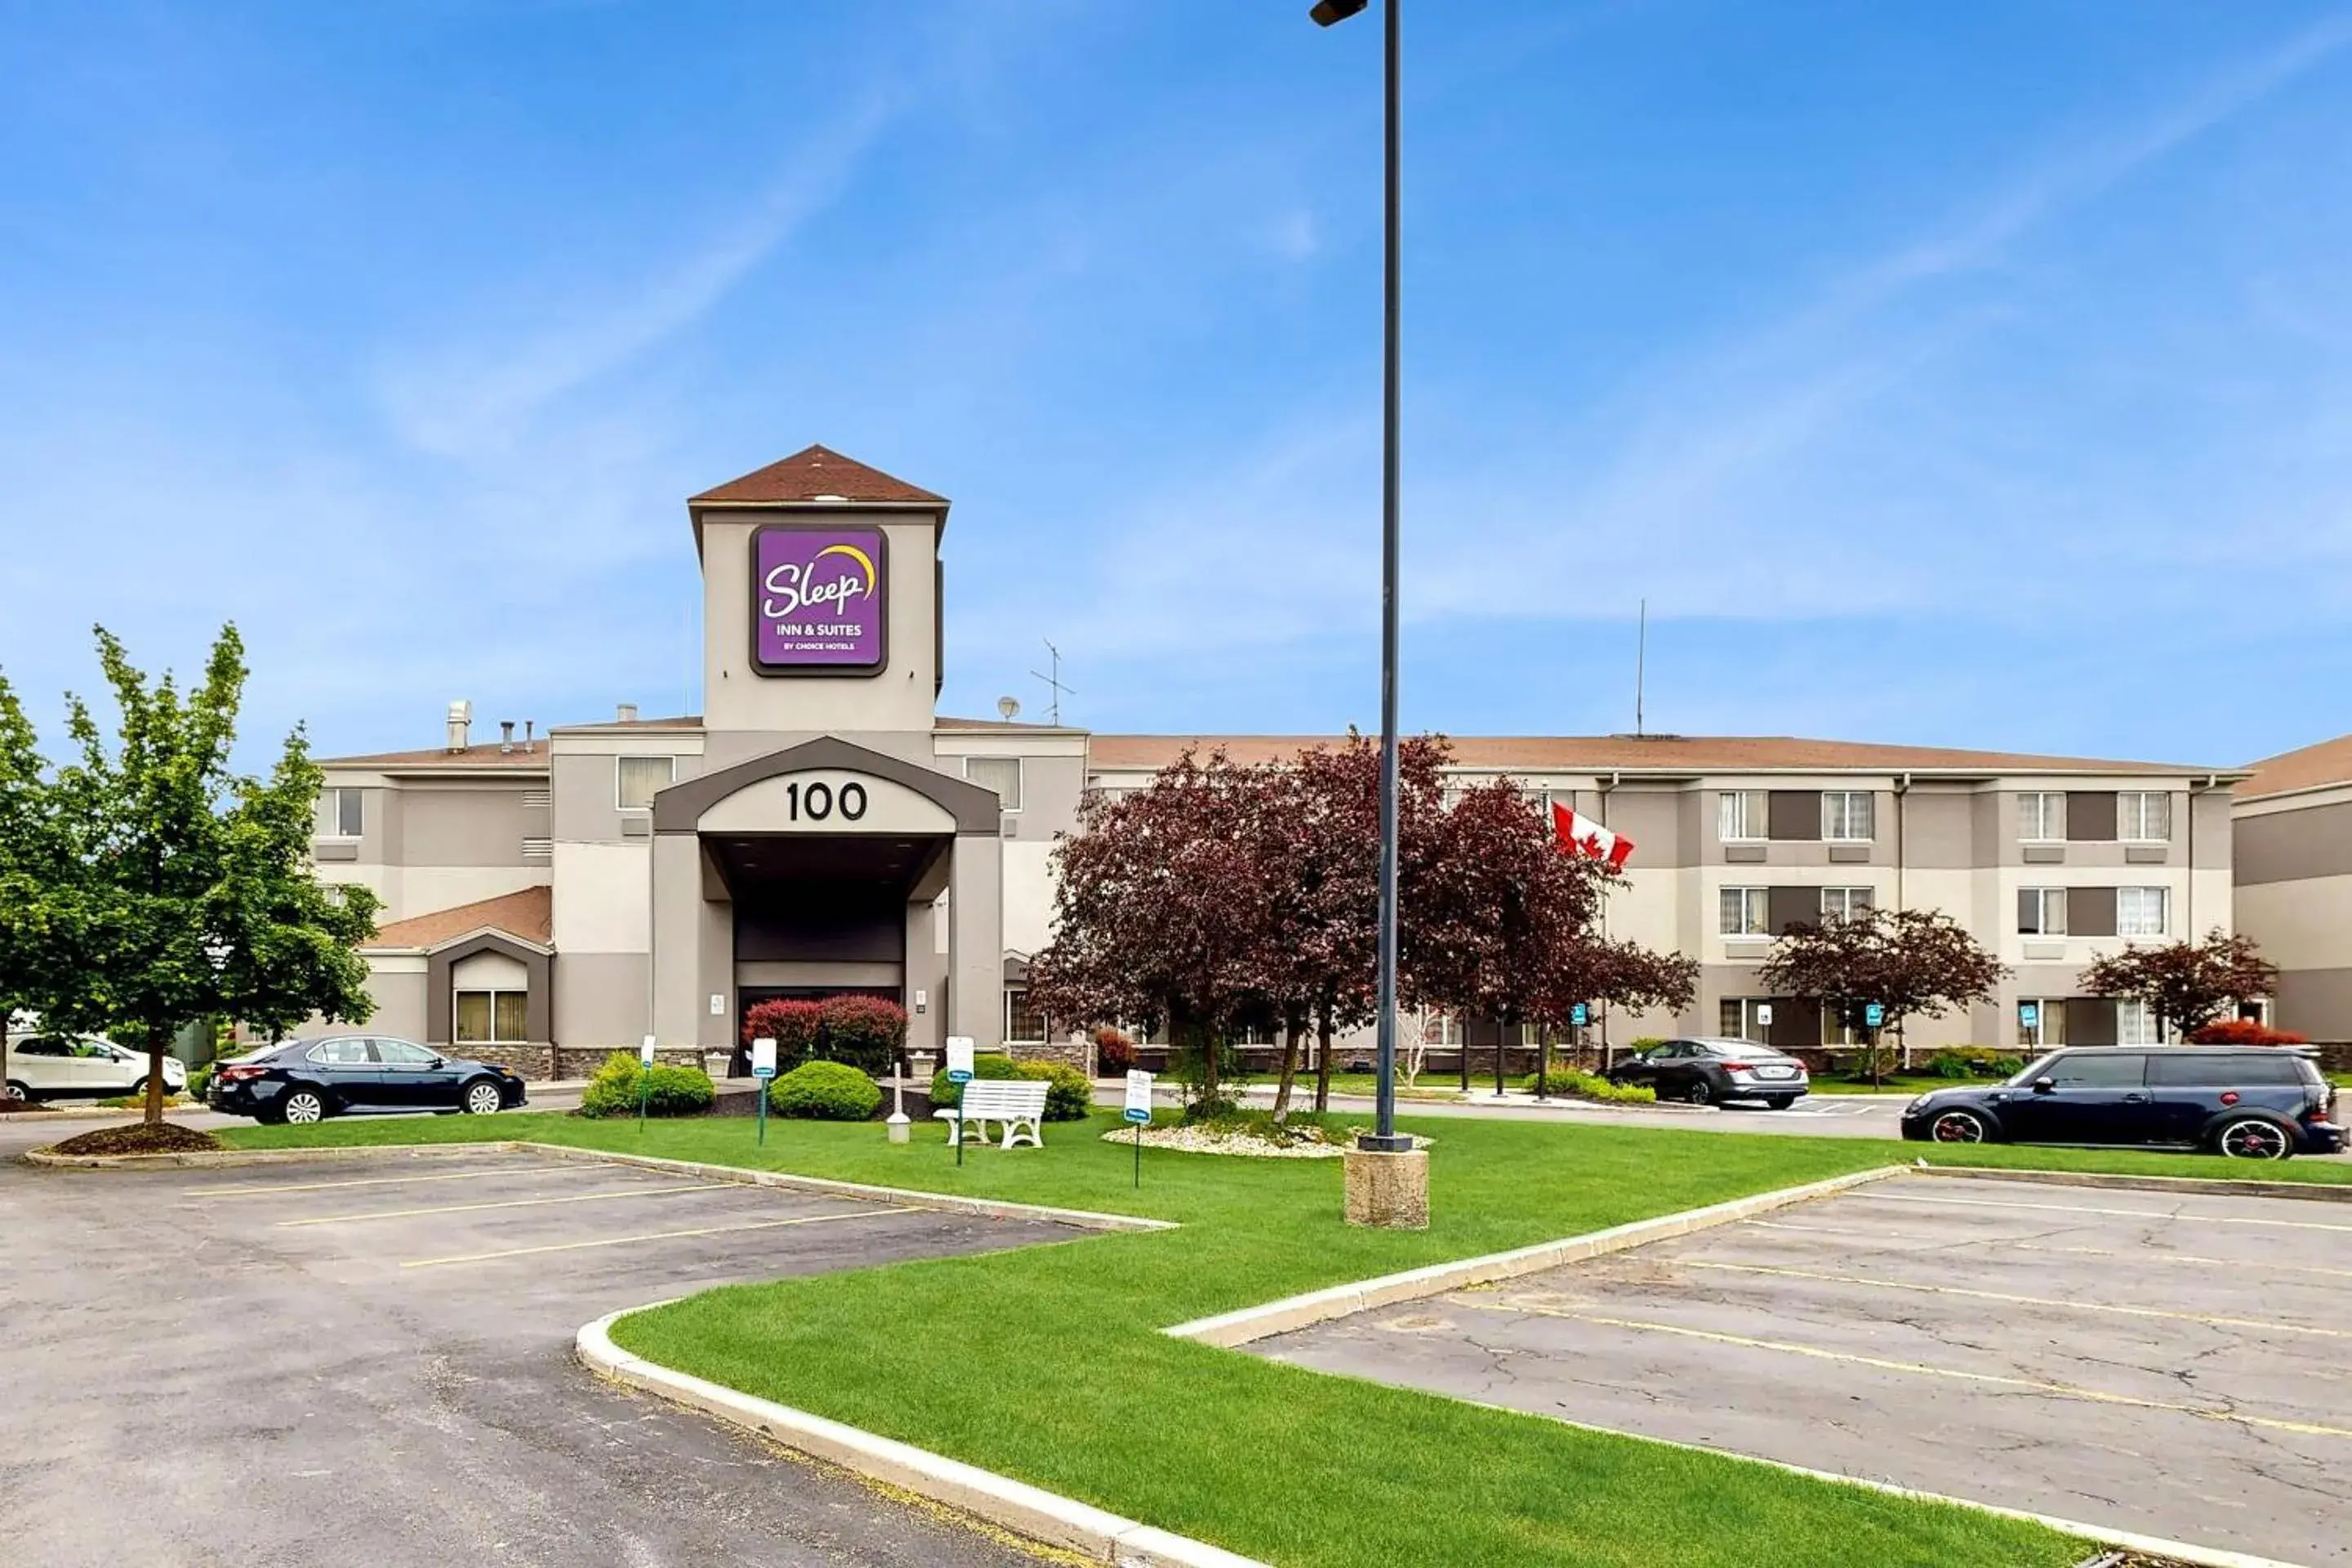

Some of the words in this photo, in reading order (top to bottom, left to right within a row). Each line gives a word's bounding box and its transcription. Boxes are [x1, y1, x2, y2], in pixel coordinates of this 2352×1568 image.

[764, 562, 864, 618] Sleep
[777, 624, 802, 636] INN
[804, 624, 815, 636] &
[817, 624, 862, 636] SUITES
[795, 642, 824, 650] CHOICE
[826, 642, 855, 650] HOTELS
[786, 782, 868, 821] 100
